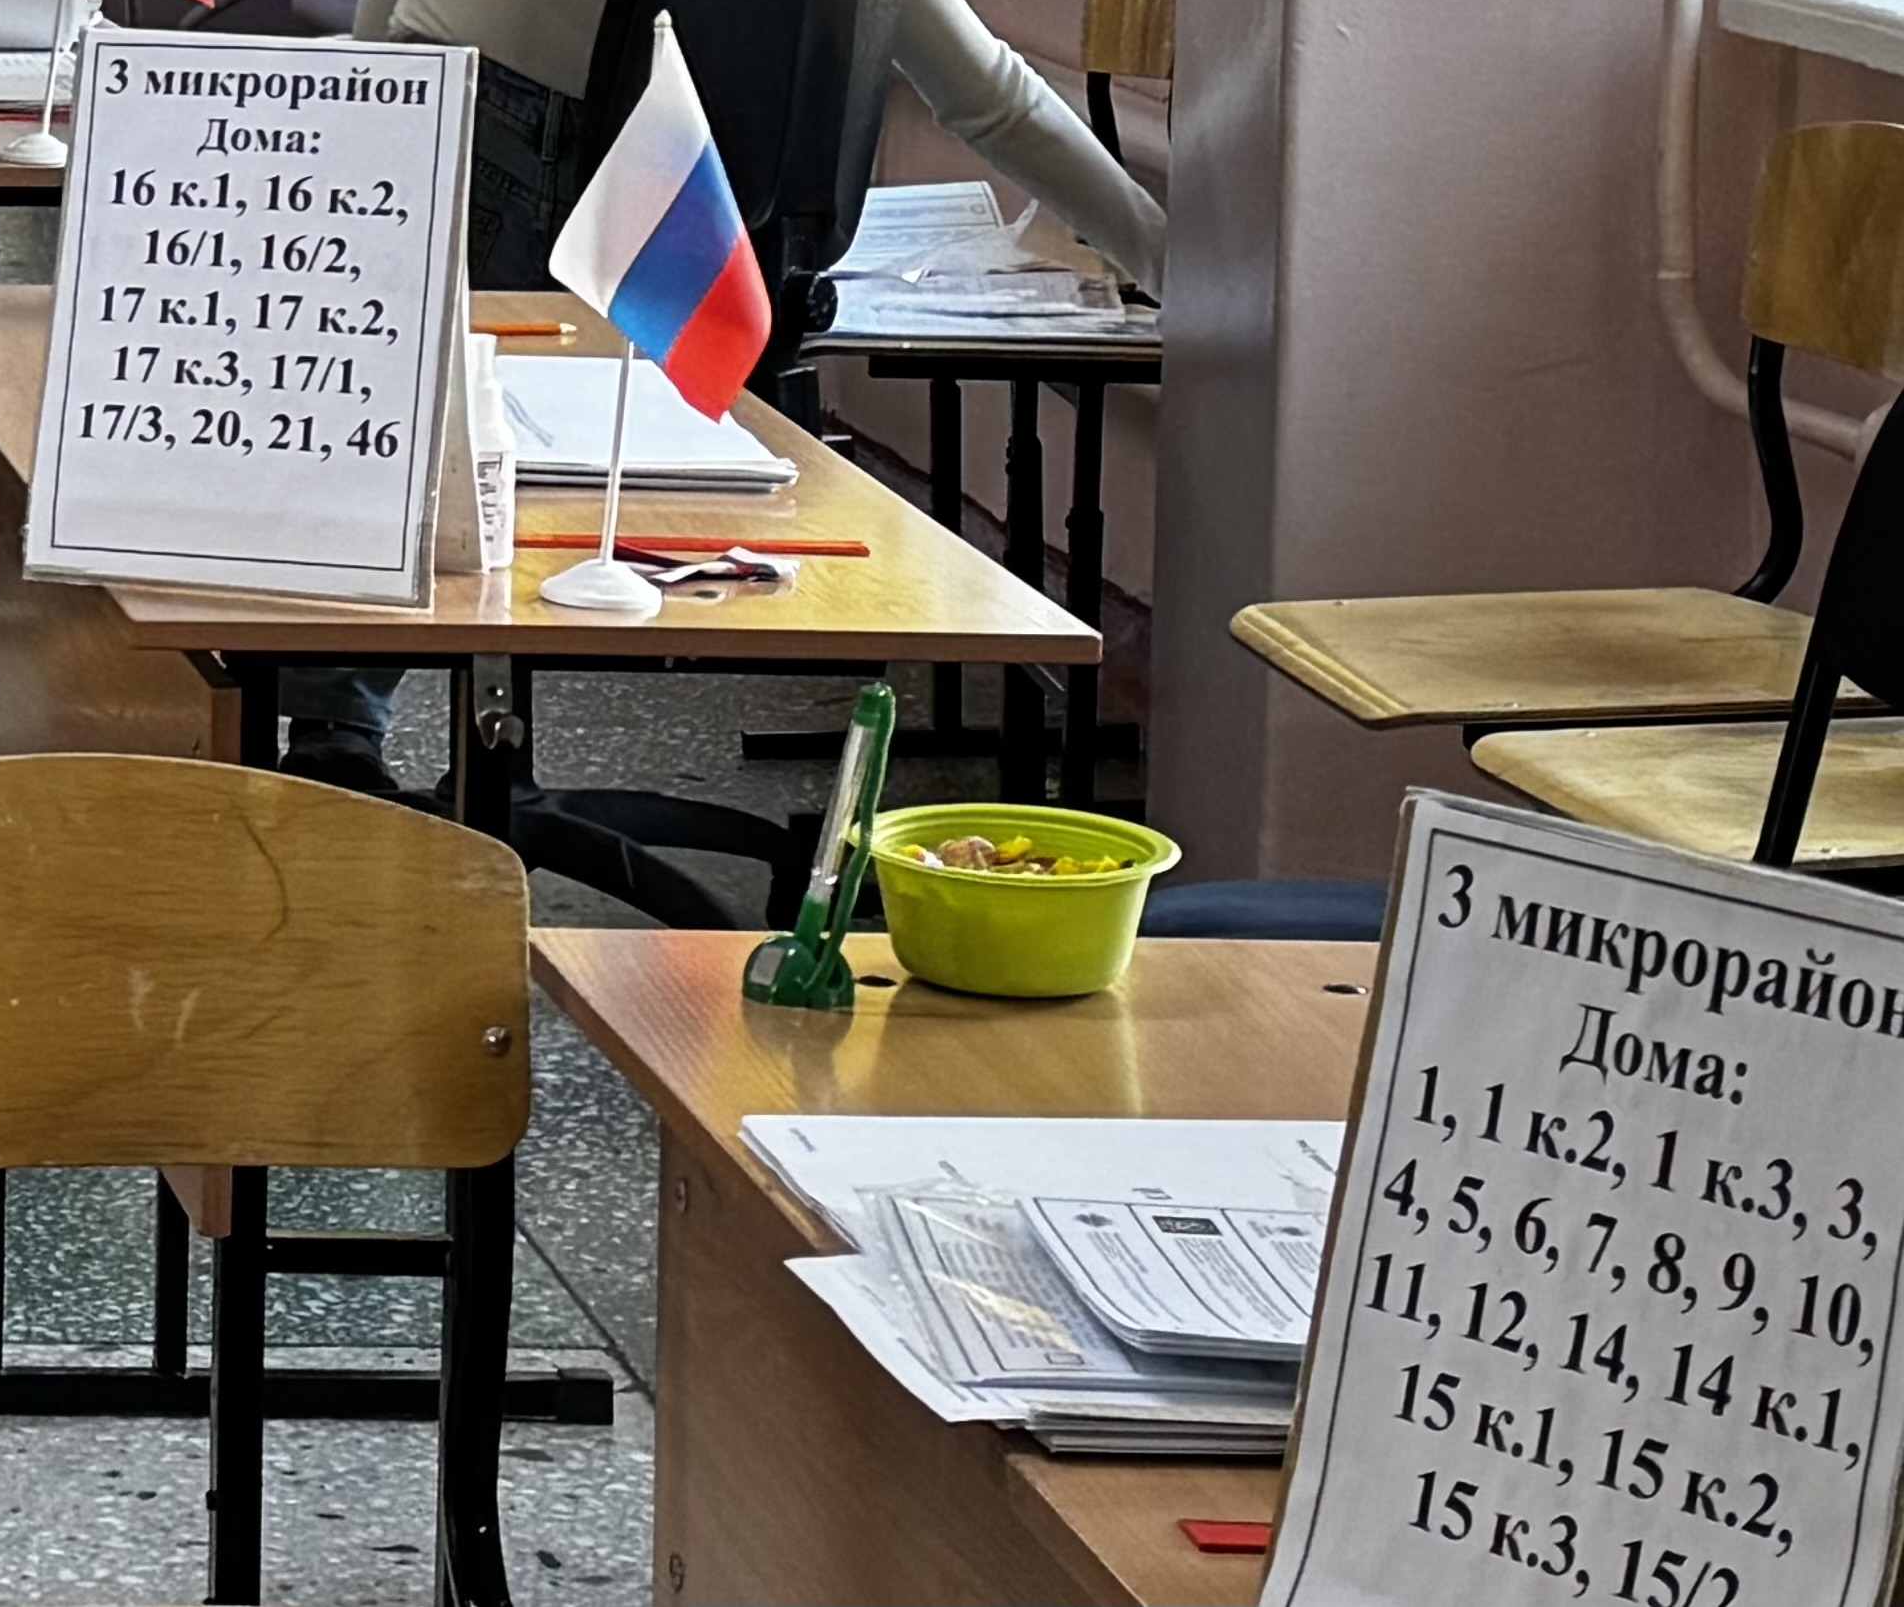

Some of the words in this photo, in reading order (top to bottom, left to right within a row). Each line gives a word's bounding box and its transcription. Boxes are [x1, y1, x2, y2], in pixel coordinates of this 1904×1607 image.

[105, 59, 129, 95] 3
[143, 66, 429, 111] микрорайон
[196, 118, 322, 157] Дома:
[110, 168, 157, 207] 16
[169, 173, 248, 218] к.1,
[264, 175, 314, 213] 16
[328, 180, 409, 225] к.2,
[144, 229, 242, 276] 16/1,
[260, 234, 362, 283] 16/2,
[99, 286, 146, 323] 17
[158, 291, 237, 335] к.1,
[254, 293, 303, 332] 17
[317, 299, 399, 345] к.2,
[112, 346, 161, 382] 17
[173, 350, 253, 395] к.3,
[269, 354, 372, 404] 17/1,
[77, 403, 177, 451] 17/3,
[191, 409, 253, 457] 20,
[267, 413, 333, 461] 21,
[346, 419, 401, 459] 46
[1437, 864, 1475, 929] 3
[1491, 894, 1904, 1040] микрорайон
[1560, 1003, 1748, 1105] Дома:
[1413, 1065, 1457, 1143] 1,
[1477, 1083, 1505, 1144] 1
[1524, 1110, 1626, 1190] к.2,
[1650, 1130, 1679, 1193] 1
[1699, 1158, 1807, 1241] к.3,
[1827, 1178, 1878, 1261] 3,
[1383, 1158, 1429, 1235] 4,
[1448, 1176, 1492, 1253] 5,
[1515, 1197, 1559, 1274] 6,
[1586, 1212, 1626, 1294] 7,
[1647, 1232, 1697, 1314] 8,
[1716, 1252, 1769, 1336] 9,
[1792, 1274, 1875, 1367] 10,
[1365, 1253, 1442, 1340] 11,
[1461, 1281, 1540, 1372] 12,
[1560, 1313, 1641, 1403] 14,
[1664, 1343, 1735, 1416] 14
[1750, 1387, 1862, 1471] к.1,
[1394, 1364, 1461, 1432] 15
[1473, 1403, 1575, 1487] к.1,
[1595, 1428, 1670, 1500] 15
[1681, 1471, 1794, 1557] к.2,
[1408, 1470, 1480, 1541] 15
[1489, 1513, 1591, 1598] к.3,
